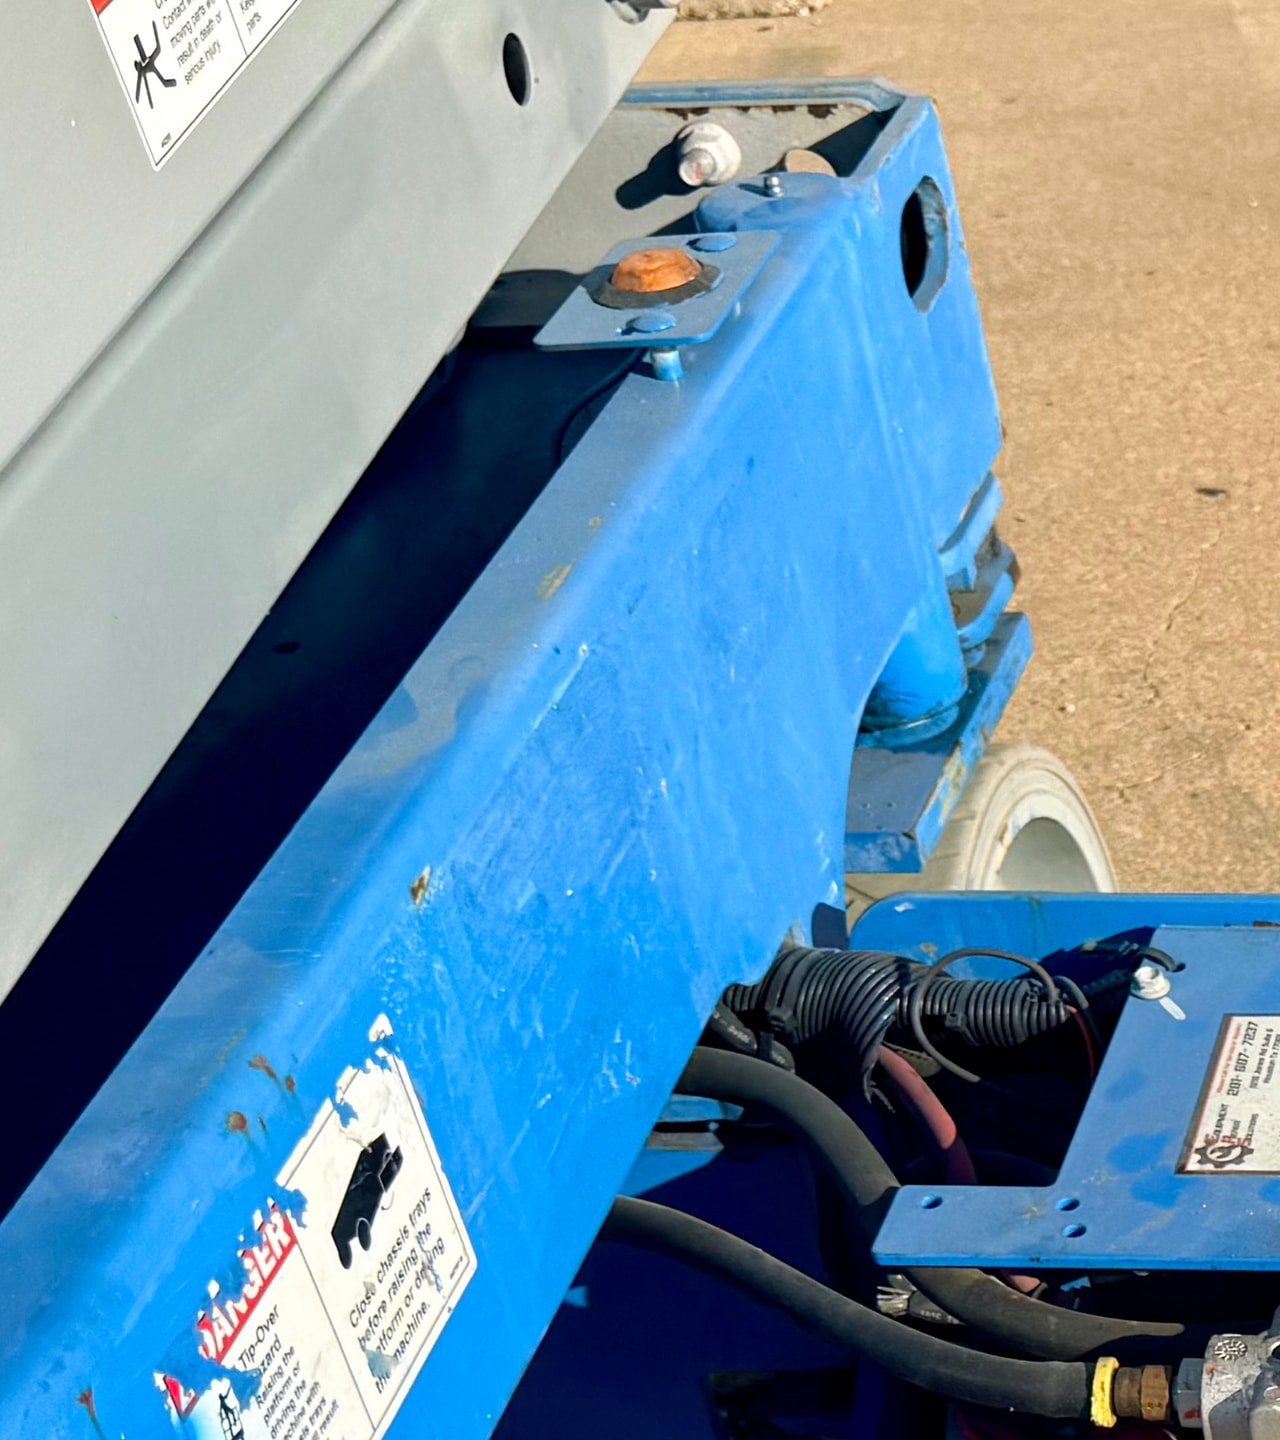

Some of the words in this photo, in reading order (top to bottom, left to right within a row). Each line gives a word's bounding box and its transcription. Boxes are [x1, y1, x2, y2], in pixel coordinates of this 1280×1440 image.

[177, 41, 194, 68] result
[376, 1224, 410, 1284] chassis
[408, 1187, 432, 1227] trays
[358, 1298, 387, 1348] before
[387, 1248, 418, 1308] raising
[404, 1286, 414, 1308] or
[238, 1305, 280, 1369] Tip-Over
[255, 1366, 284, 1409] Raising
[282, 1346, 295, 1366] the
[263, 1375, 293, 1428] platform
[293, 1360, 300, 1377] or
[306, 1381, 321, 1407] with
[270, 1399, 297, 1439] driving
[294, 1380, 307, 1400] the
[309, 1396, 327, 1426] trays
[319, 1398, 339, 1435] result
